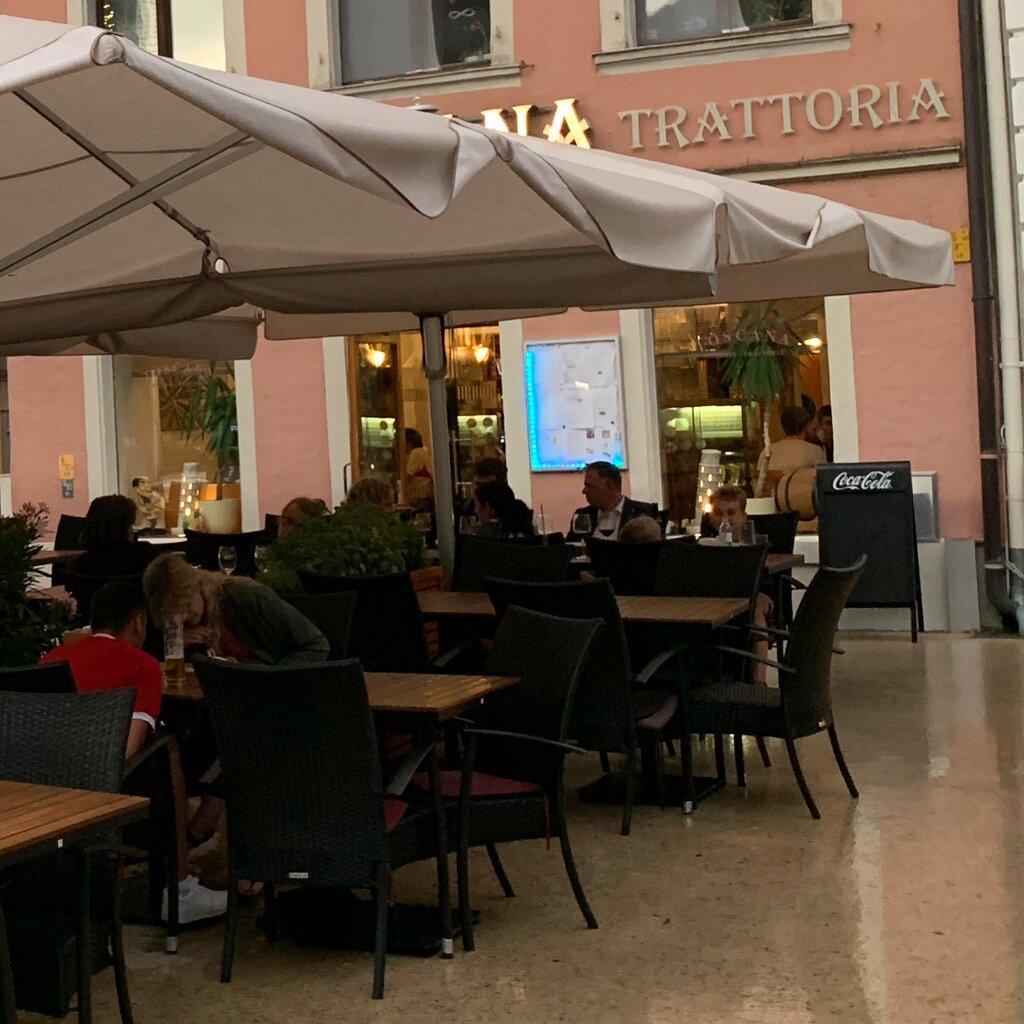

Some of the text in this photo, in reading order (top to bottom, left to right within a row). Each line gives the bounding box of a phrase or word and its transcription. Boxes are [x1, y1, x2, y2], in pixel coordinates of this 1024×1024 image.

[443, 77, 951, 150] NA TRATTORIA
[832, 470, 895, 491] Coca-Cola
